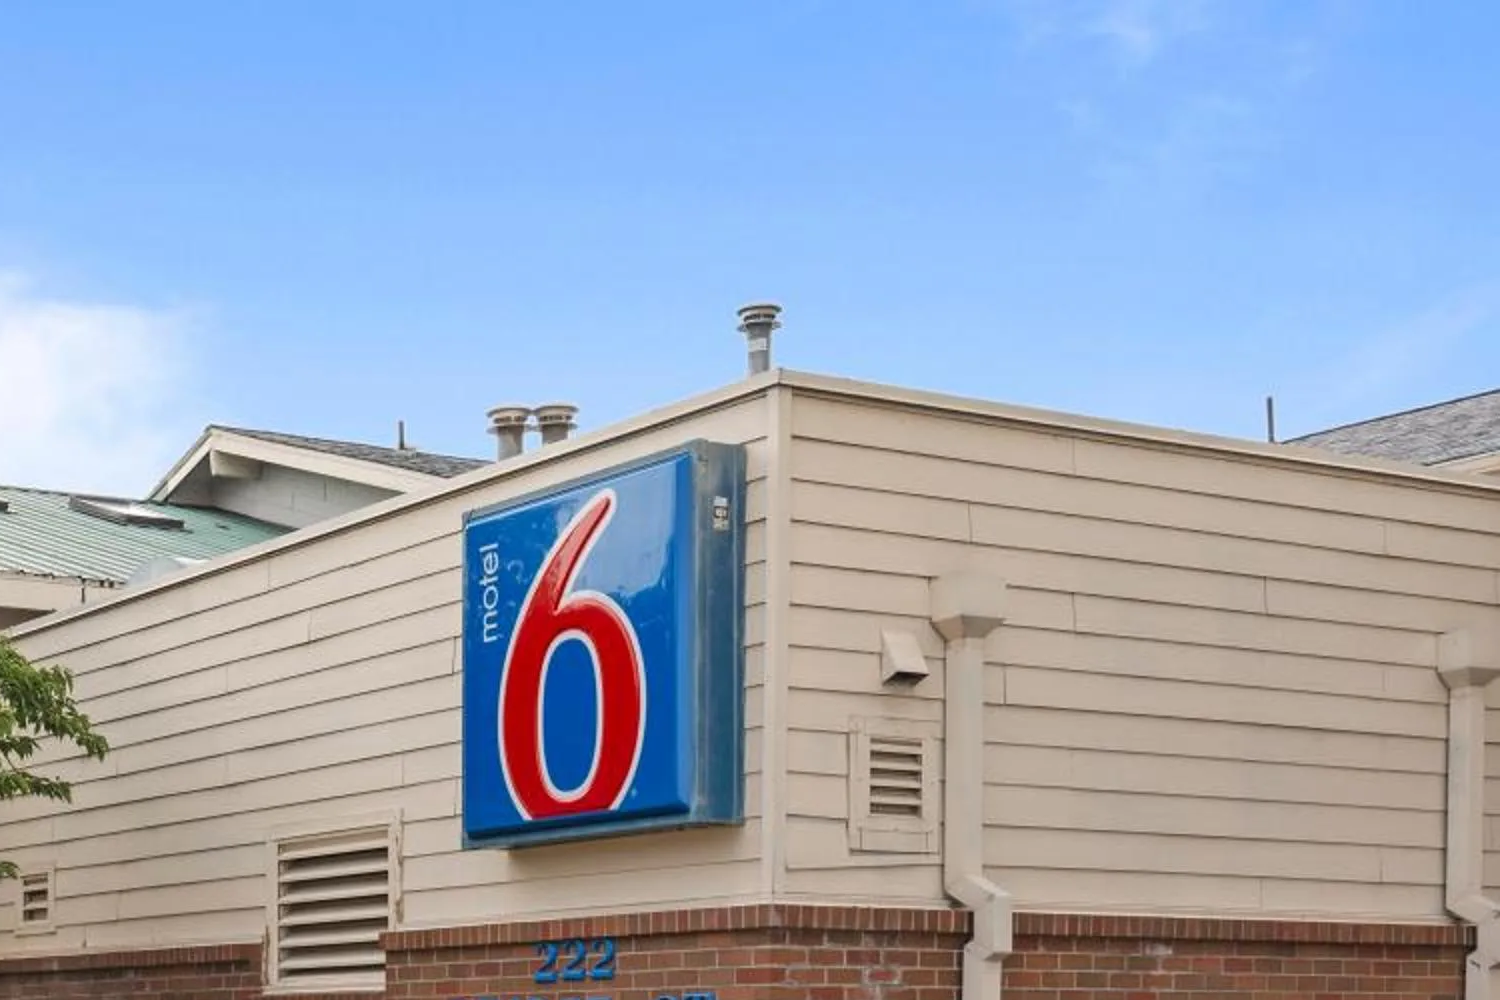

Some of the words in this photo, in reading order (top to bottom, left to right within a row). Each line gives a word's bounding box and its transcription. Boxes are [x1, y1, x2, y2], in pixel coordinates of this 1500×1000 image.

[481, 542, 500, 644] motel
[497, 488, 647, 821] 6
[533, 936, 617, 984] 222
